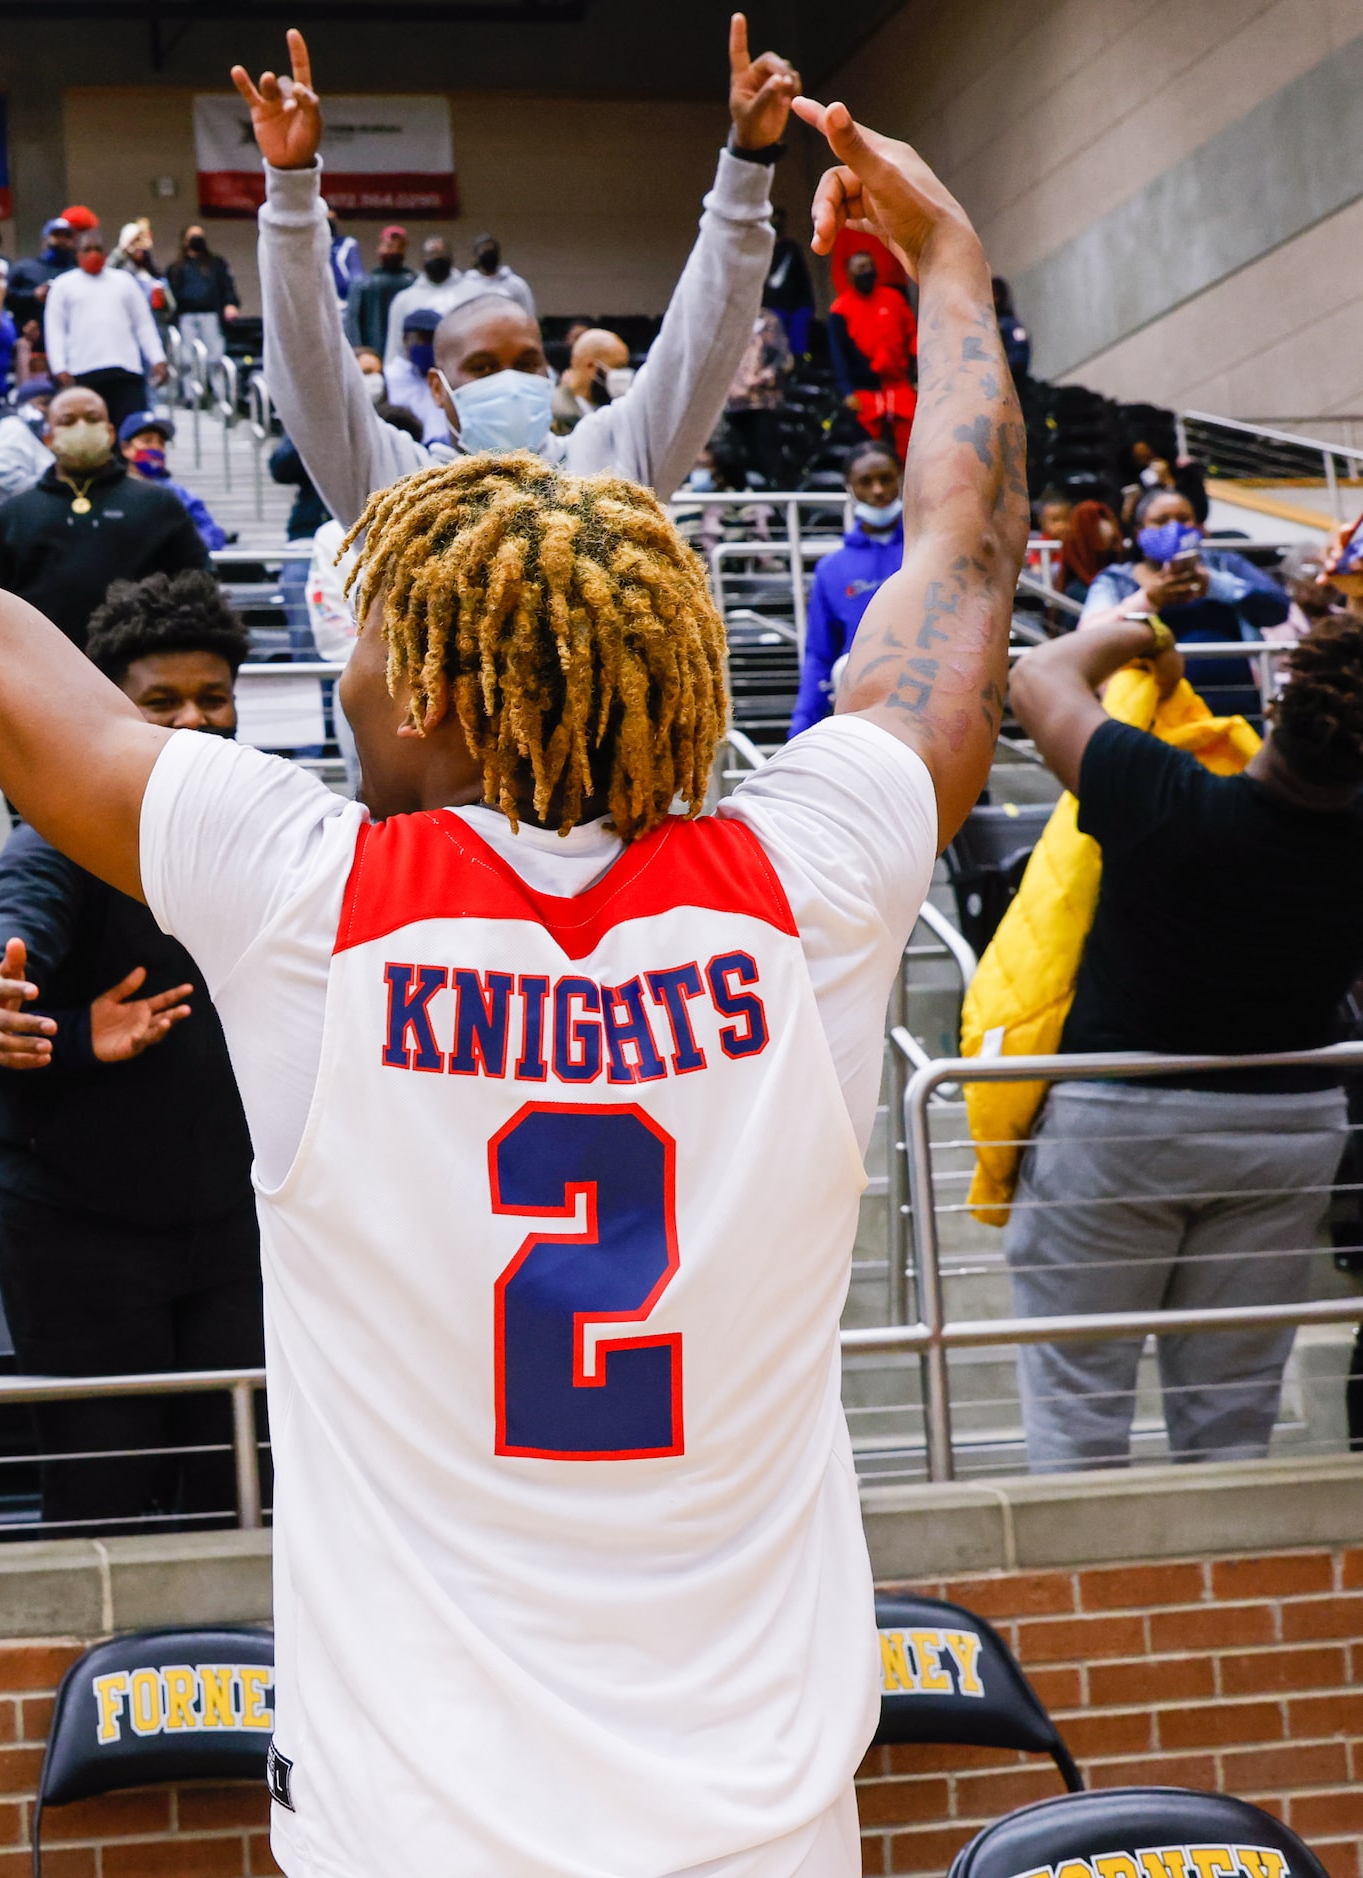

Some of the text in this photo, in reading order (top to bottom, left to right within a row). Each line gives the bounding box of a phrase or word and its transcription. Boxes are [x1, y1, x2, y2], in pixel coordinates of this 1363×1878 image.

[381, 949, 771, 1085] KNIGHTS
[487, 1100, 685, 1461] 2
[93, 1664, 275, 1746] FORNE
[878, 1627, 985, 1698] NEY
